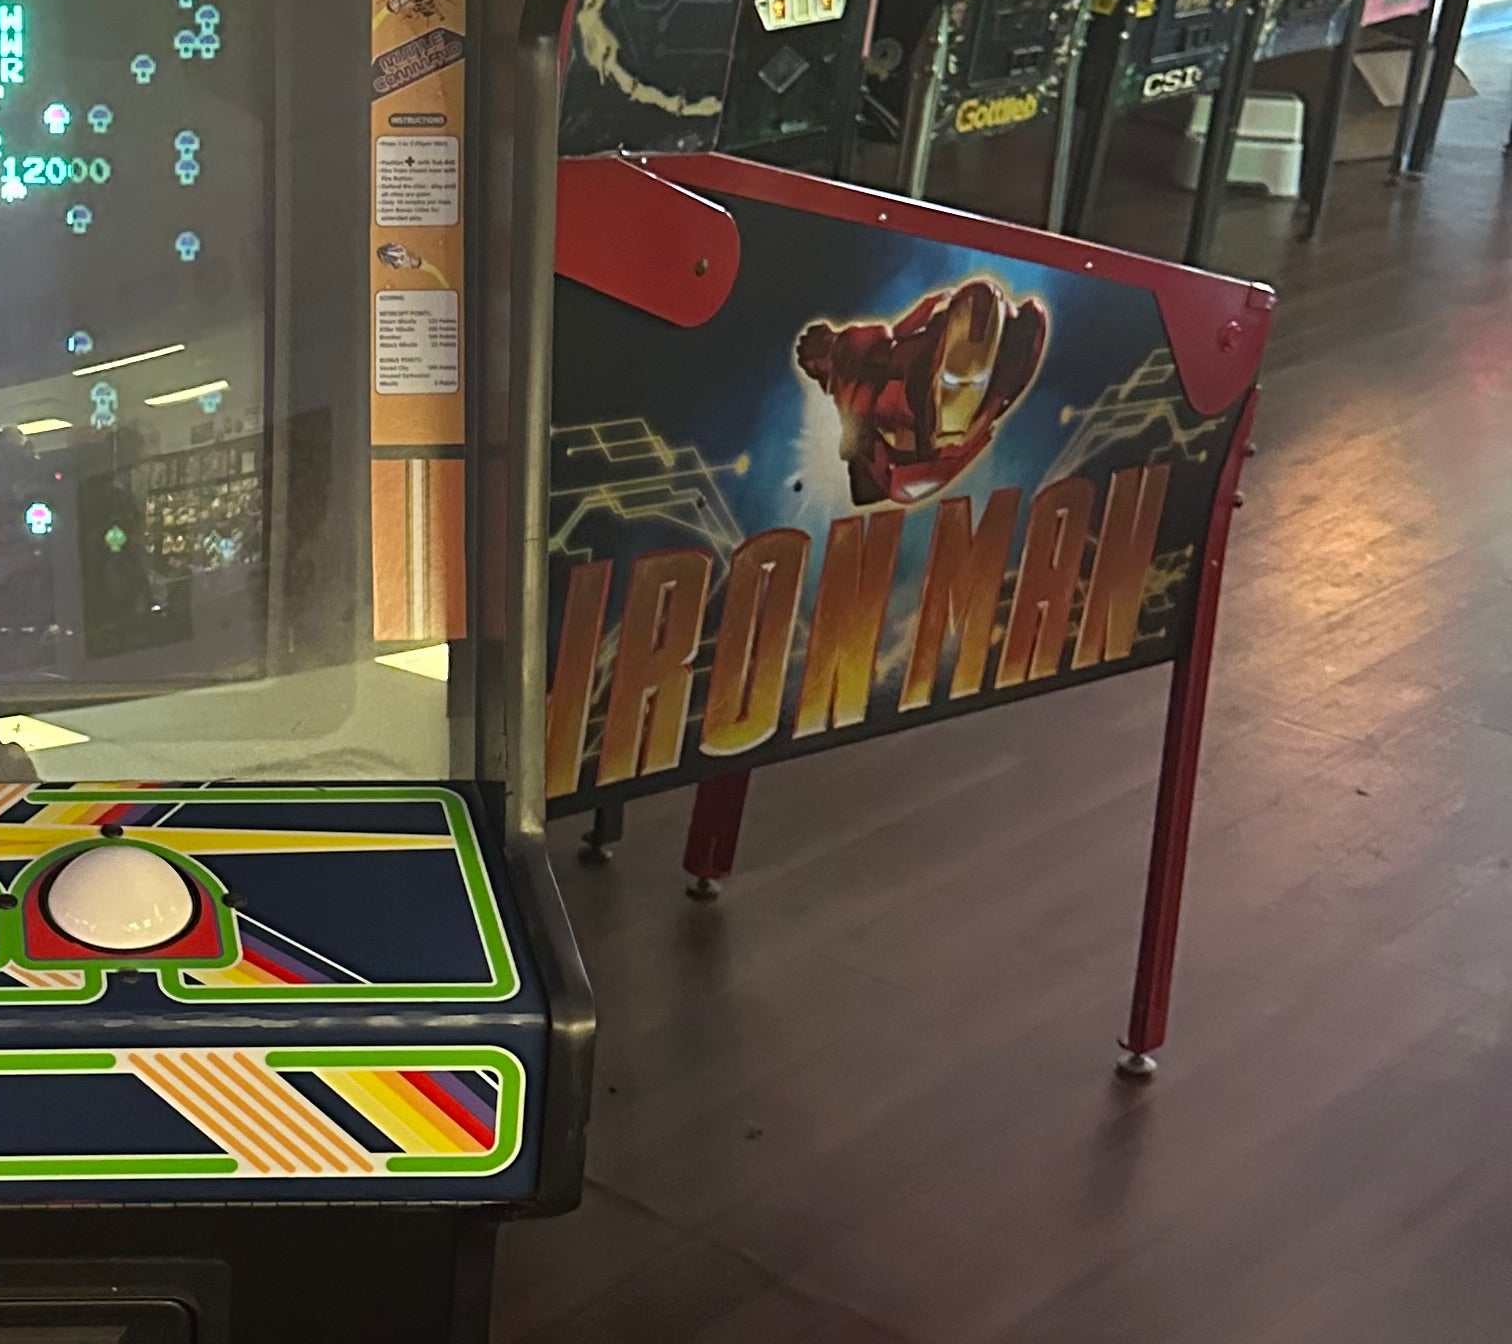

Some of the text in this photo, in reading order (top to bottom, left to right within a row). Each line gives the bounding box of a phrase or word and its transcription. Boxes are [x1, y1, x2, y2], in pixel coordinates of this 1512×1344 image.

[1, 157, 111, 184] 12000
[545, 462, 1172, 800] IRON MAN
